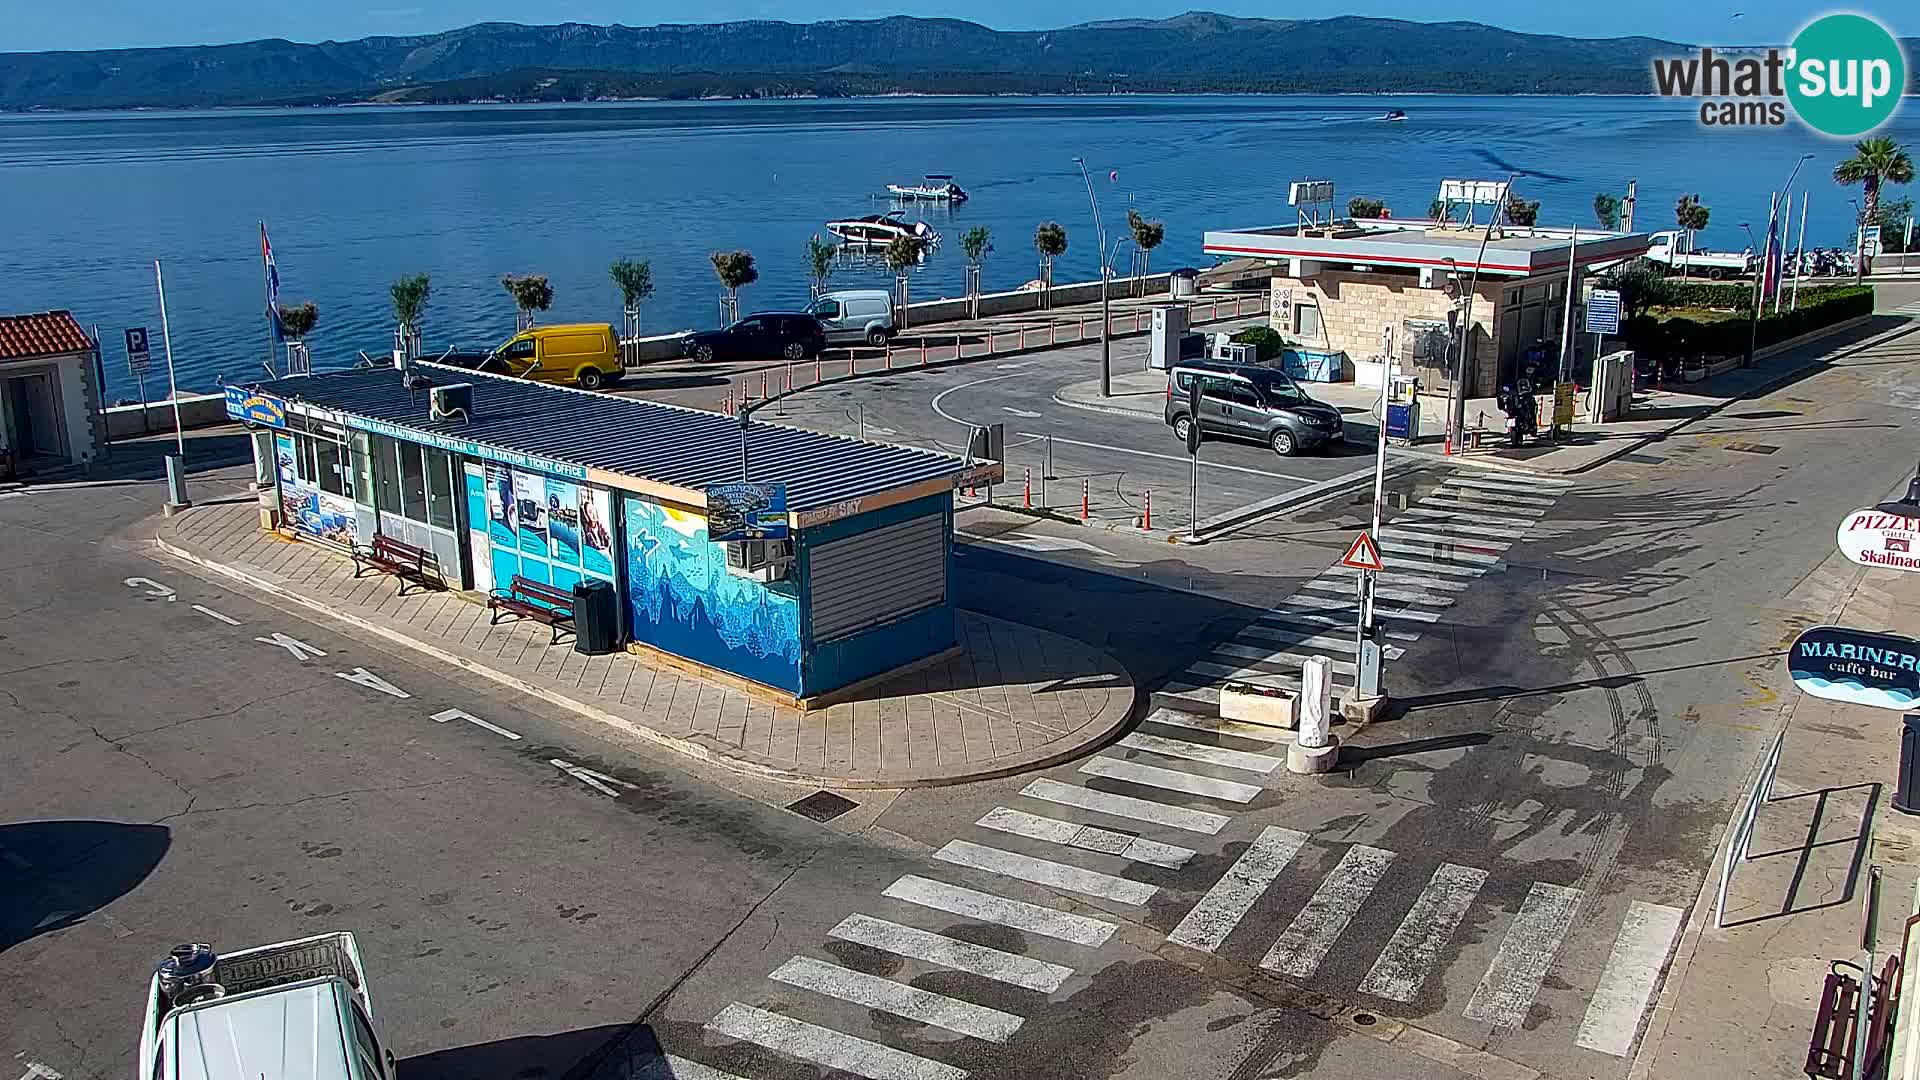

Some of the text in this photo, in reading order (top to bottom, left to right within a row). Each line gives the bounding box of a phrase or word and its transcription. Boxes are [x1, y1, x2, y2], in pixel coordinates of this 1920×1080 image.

[395, 424, 436, 443] AUTOBUSNA
[436, 434, 467, 451] POSTAJA
[478, 446, 495, 459] BUS
[494, 449, 527, 465] STATION
[527, 457, 554, 471] TICKET
[555, 463, 583, 477] OFFICE
[1848, 515, 1920, 533] PIZZE
[1829, 661, 1897, 680] caffe bar
